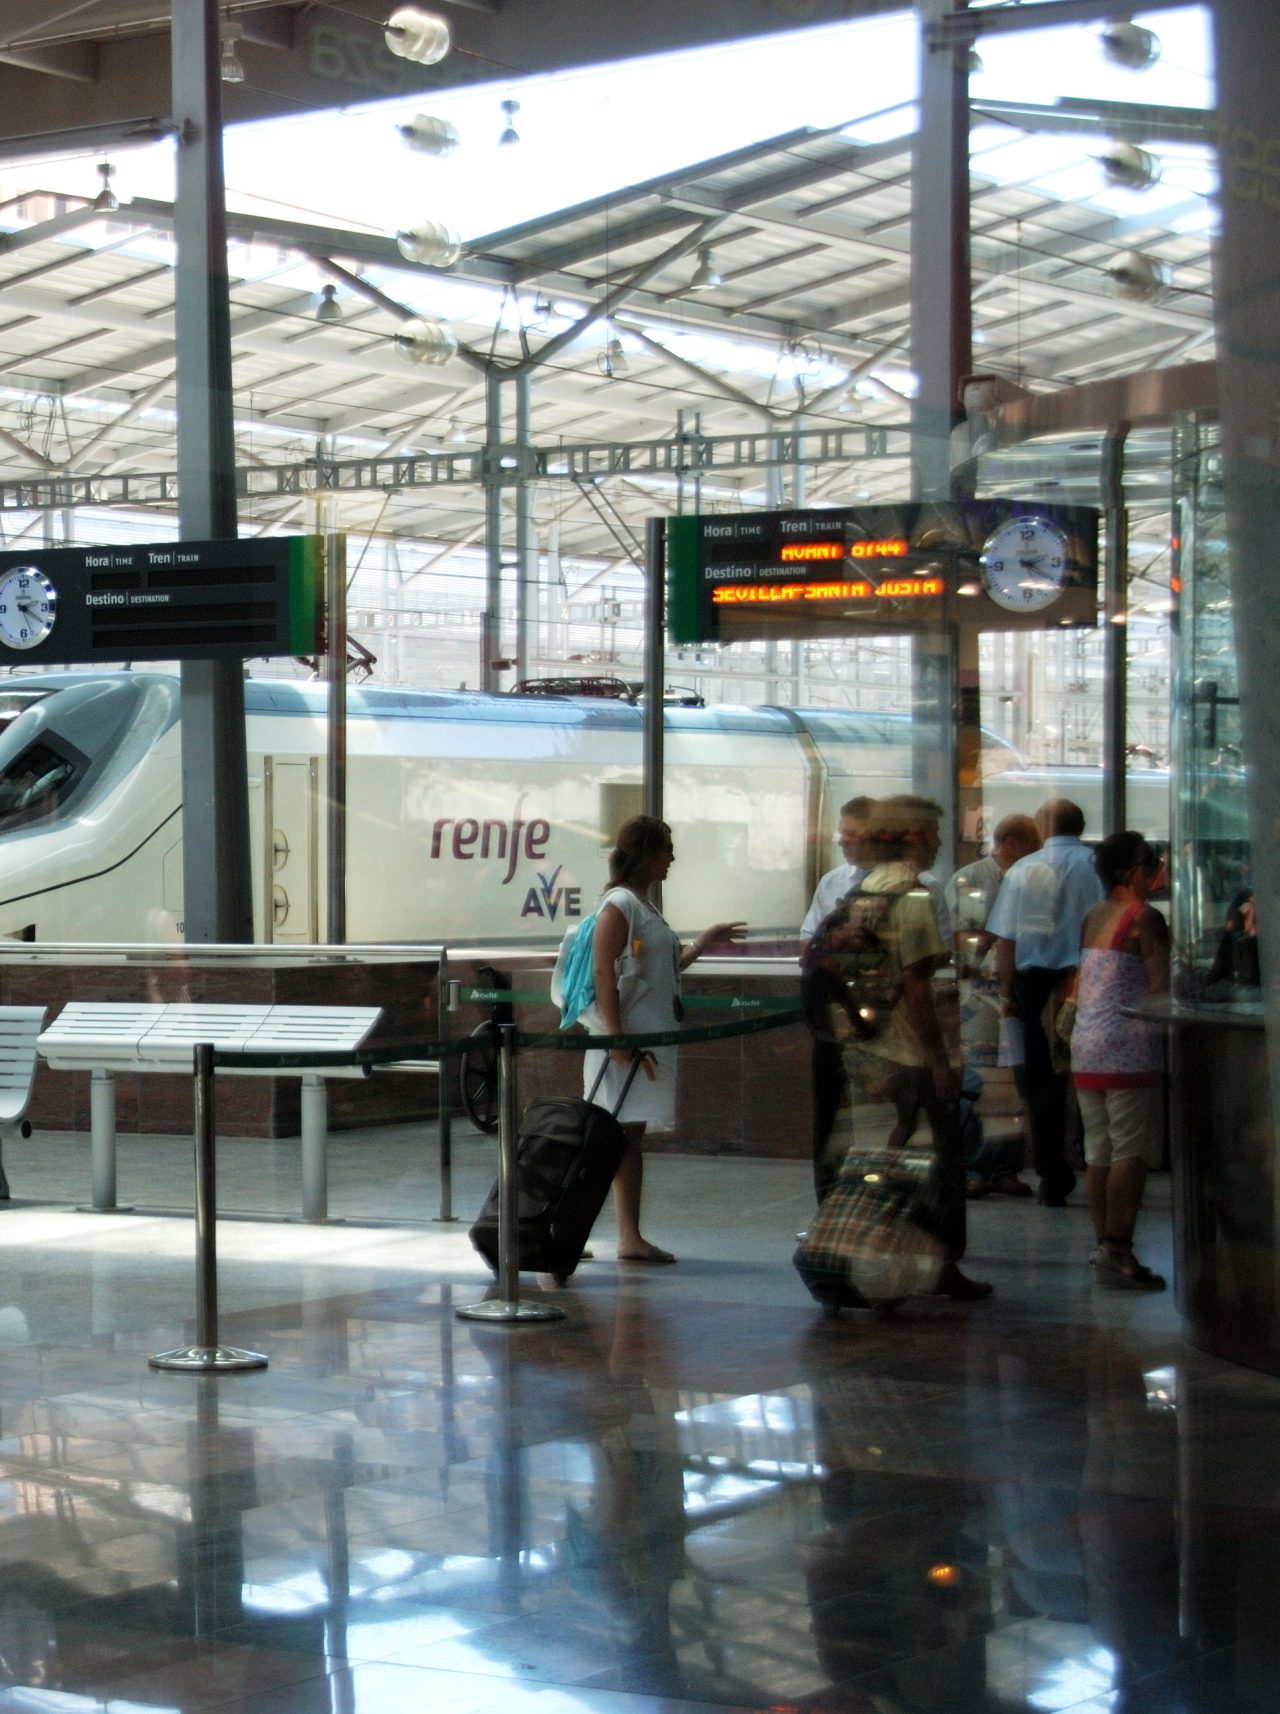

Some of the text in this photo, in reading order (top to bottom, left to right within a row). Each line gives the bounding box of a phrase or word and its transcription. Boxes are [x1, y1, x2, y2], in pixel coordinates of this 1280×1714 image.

[704, 520, 842, 537] Hora TIME Tren TRAIN
[1021, 530, 1036, 540] 12
[85, 553, 199, 567] Hora TIME Tren TRAIN
[1051, 557, 1061, 568] 3
[994, 561, 1004, 572] 9
[705, 566, 807, 579] Destino DESTINATION
[18, 579, 30, 588] 12
[86, 593, 170, 606] Destino DESTINATION
[1023, 589, 1033, 599] 6
[0, 604, 7, 614] 9
[41, 602, 48, 612] 3
[21, 629, 28, 639] 6
[431, 791, 550, 885] renfe
[521, 865, 581, 922] AVE
